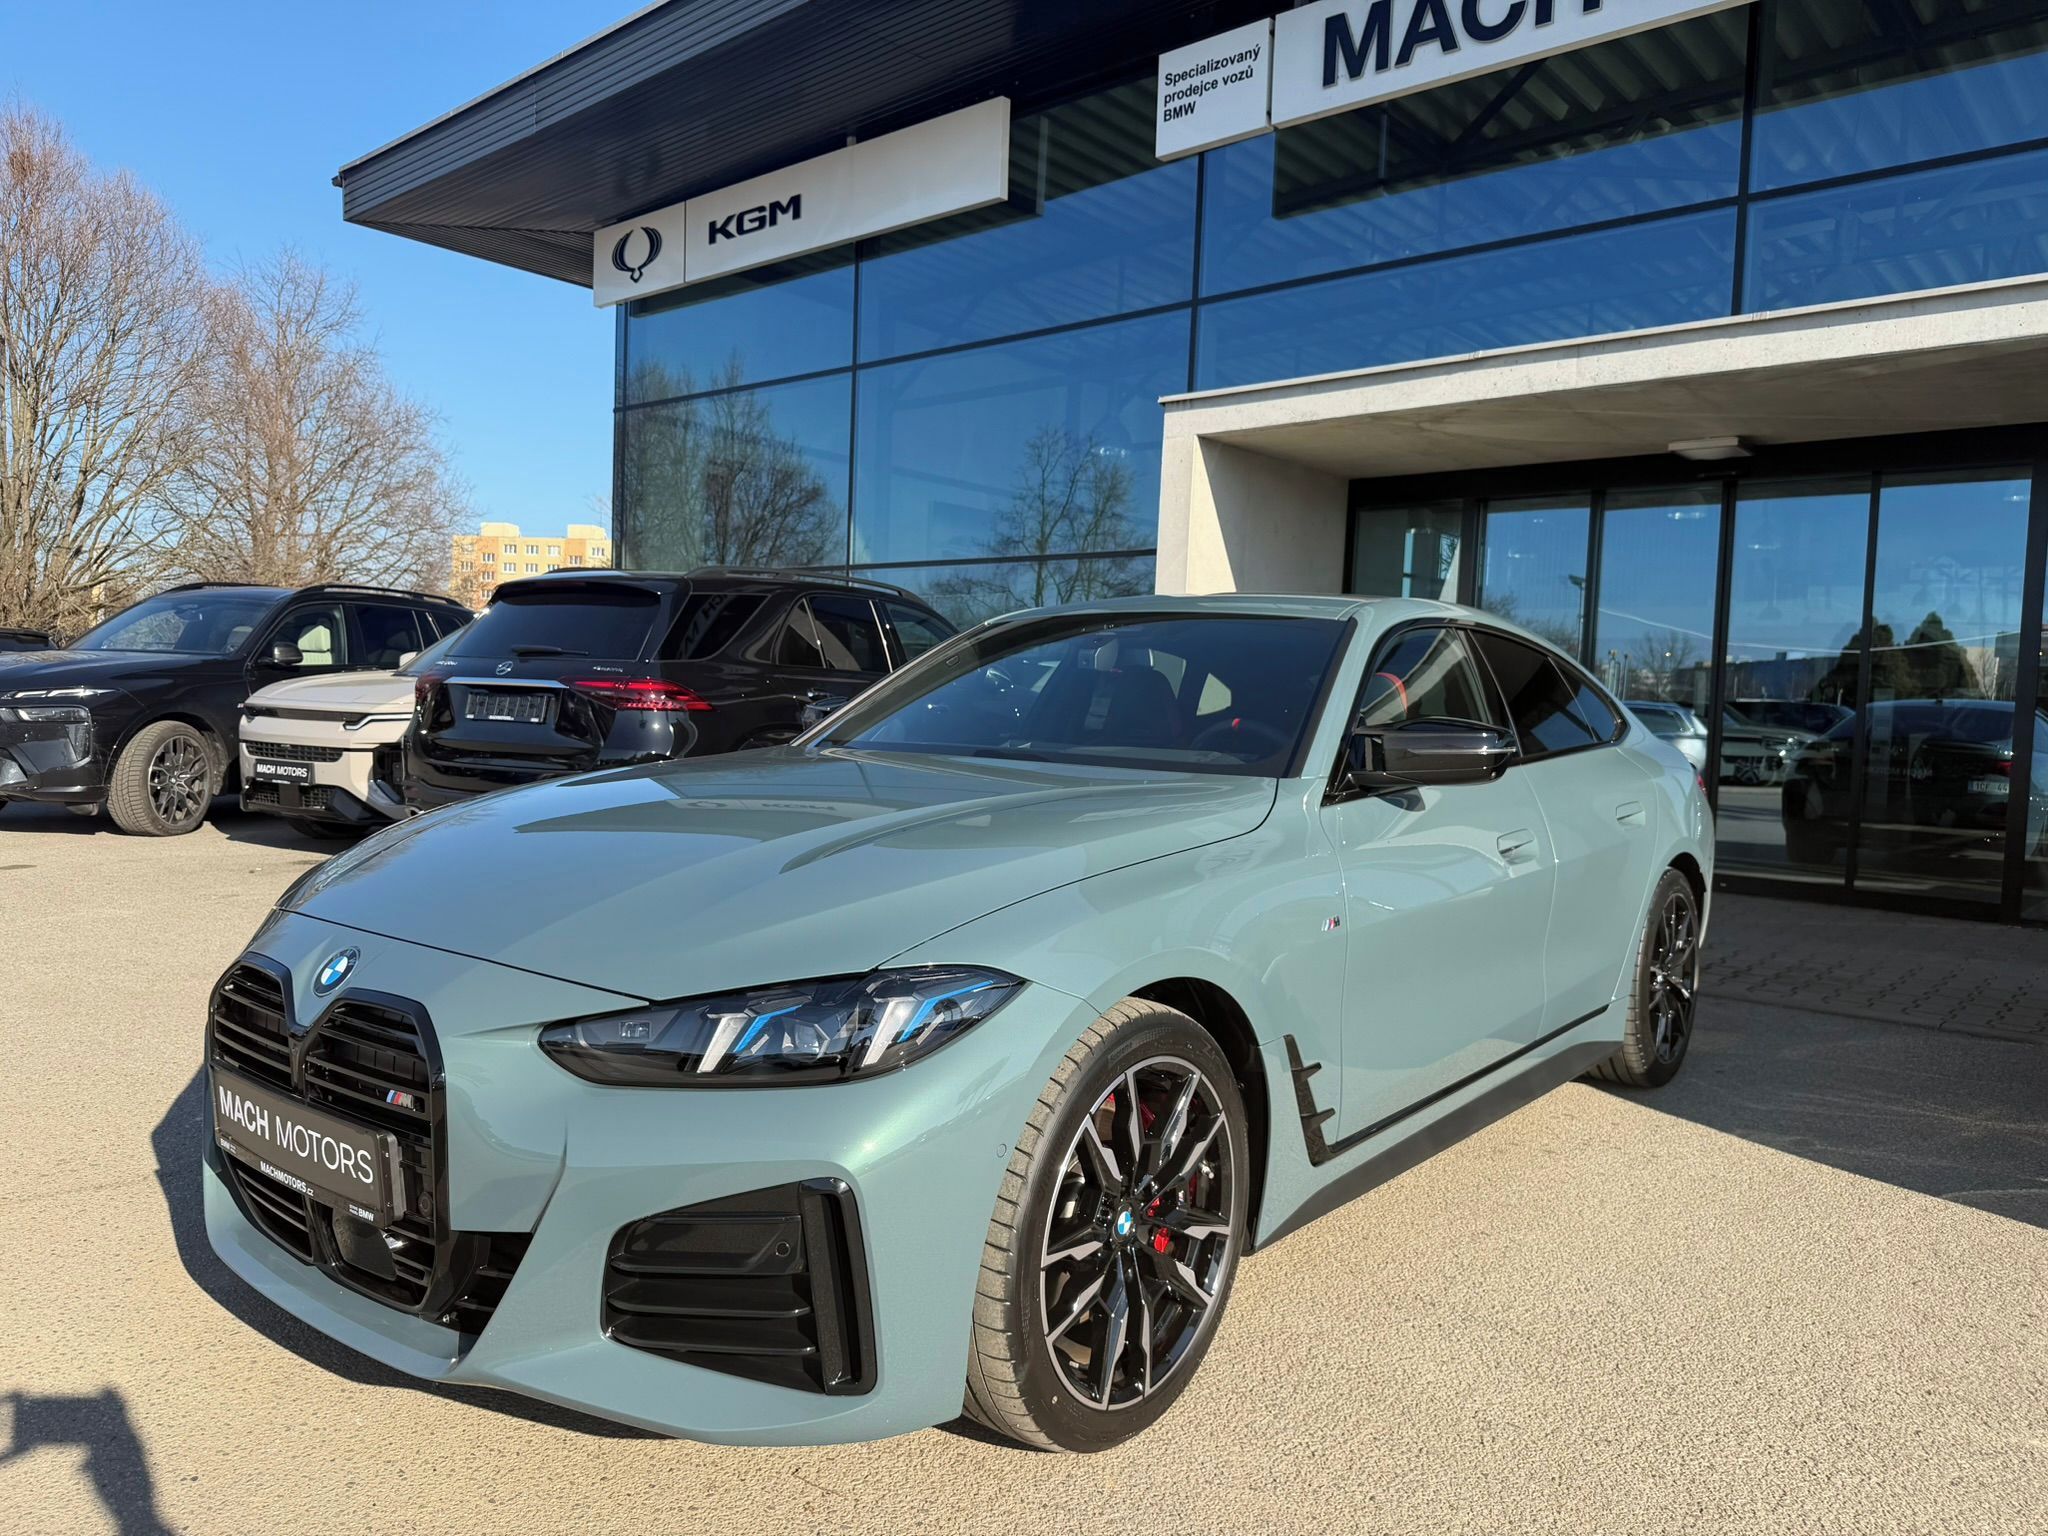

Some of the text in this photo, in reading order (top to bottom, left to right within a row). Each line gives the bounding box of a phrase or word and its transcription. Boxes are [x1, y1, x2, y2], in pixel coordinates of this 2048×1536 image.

[1164, 43, 1261, 87] Specializovaný
[1164, 64, 1254, 107] prodejce vozů
[1163, 101, 1197, 123] BMW
[708, 193, 802, 246] KGM
[256, 763, 309, 778] MACH MOTORS
[218, 1085, 374, 1184] MACH MOTORS
[358, 1207, 375, 1222] BMW
